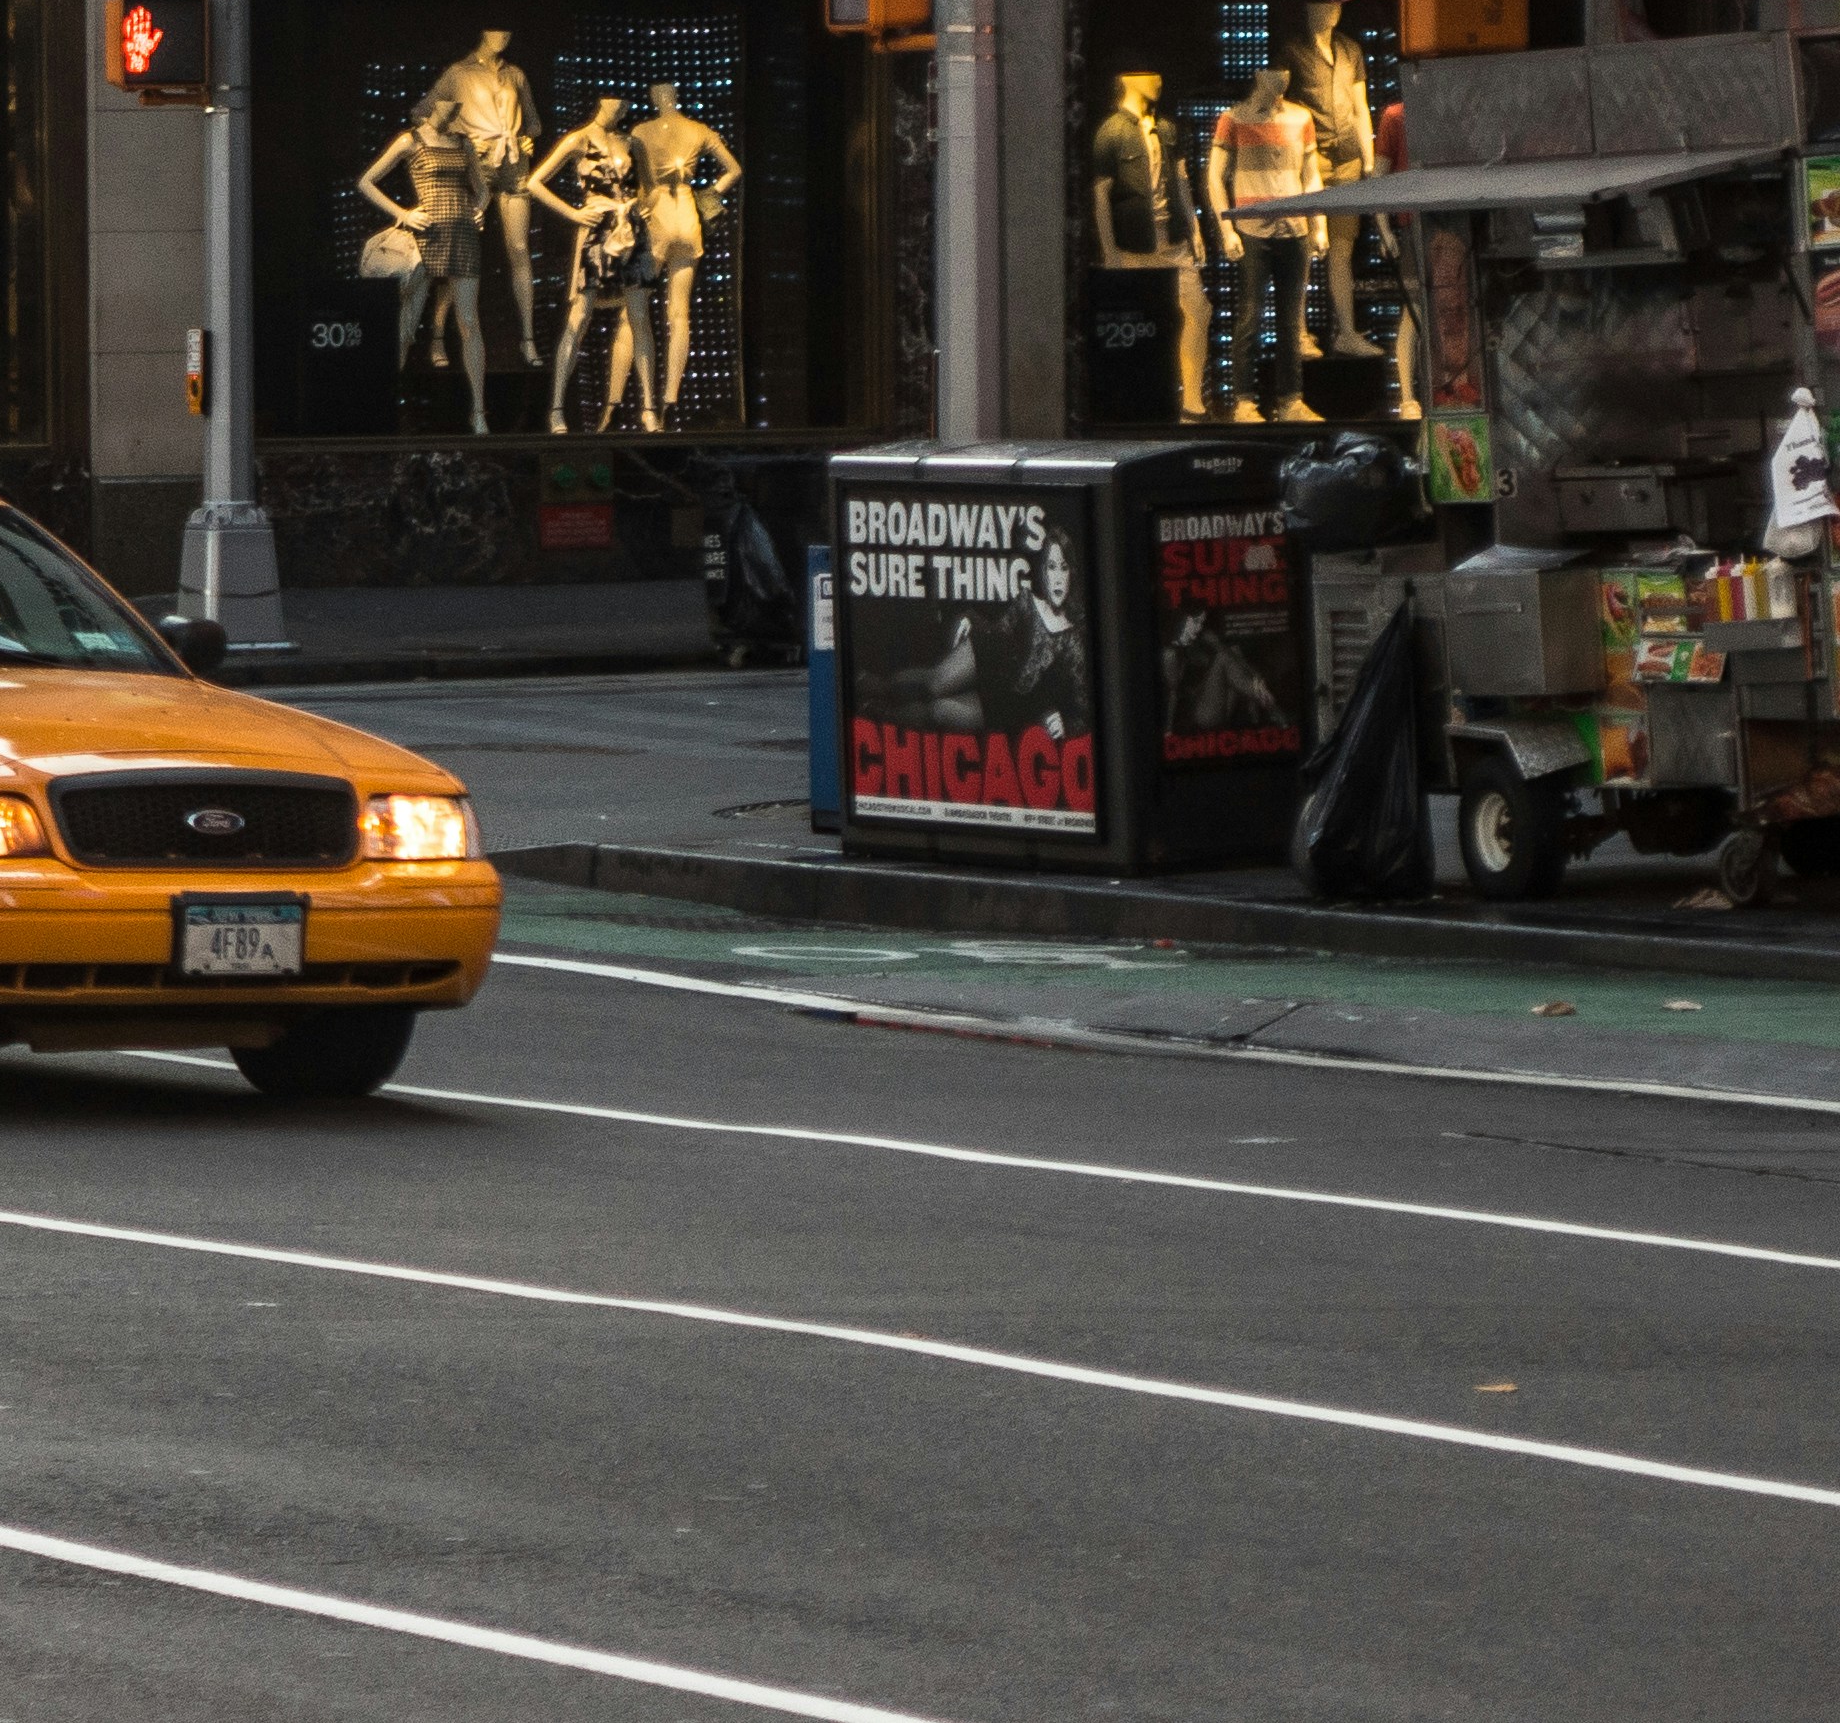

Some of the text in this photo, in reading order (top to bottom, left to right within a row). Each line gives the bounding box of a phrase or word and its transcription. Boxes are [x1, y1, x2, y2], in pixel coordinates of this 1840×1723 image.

[311, 322, 363, 348] 30%
[1499, 469, 1515, 497] 3
[849, 500, 1046, 551] BROADWAY'S
[1160, 511, 1285, 542] BROADWAY'S
[850, 551, 1032, 601] SURE THING
[1163, 574, 1288, 609] THING
[1164, 725, 1301, 761] CHICAGO
[854, 716, 1095, 813] CHICAGO
